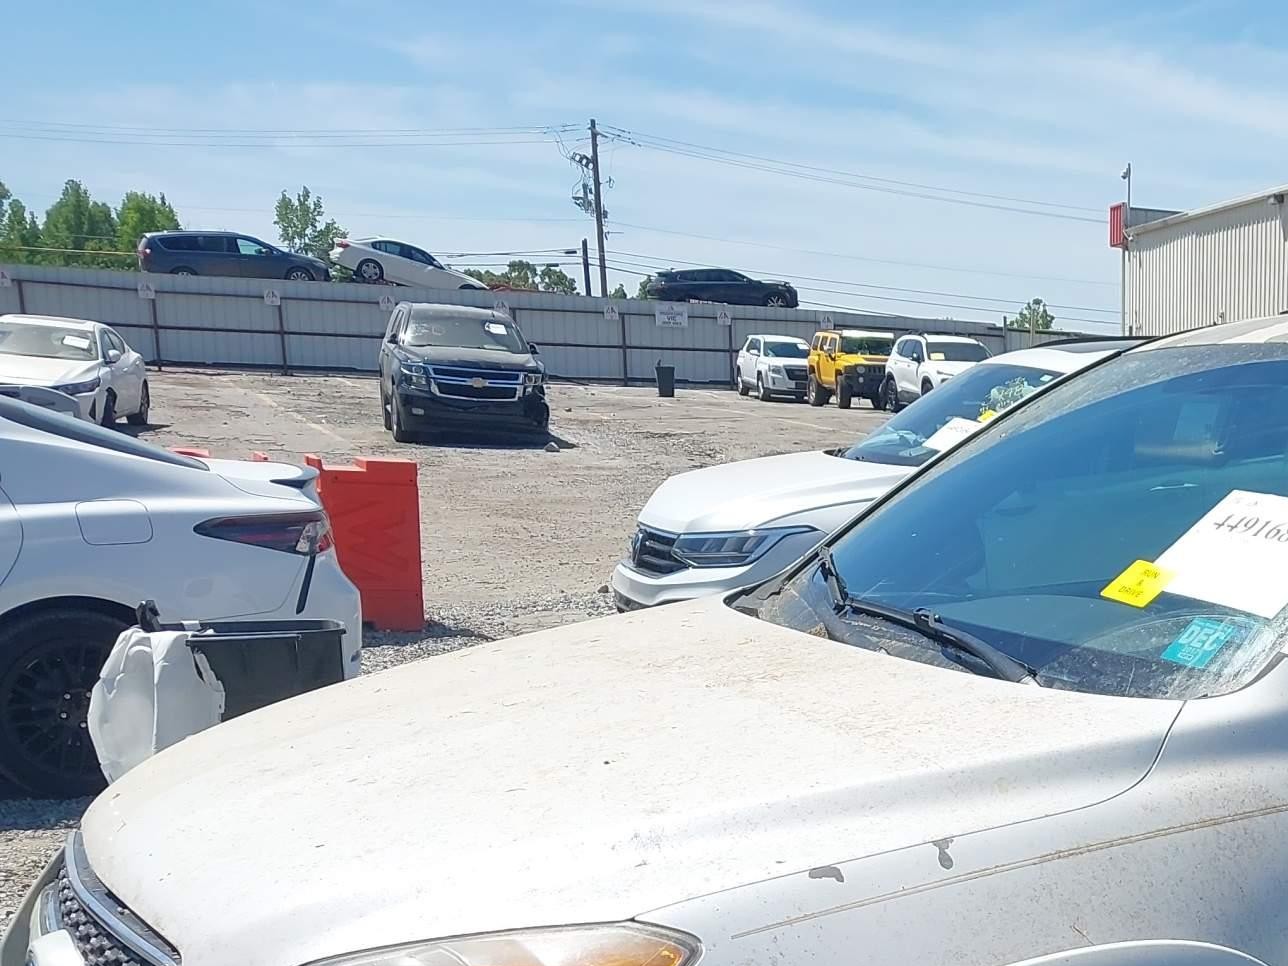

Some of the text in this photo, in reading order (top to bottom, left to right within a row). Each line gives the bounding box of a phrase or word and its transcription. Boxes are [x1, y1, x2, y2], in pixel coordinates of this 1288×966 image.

[1143, 569, 1160, 579] RUN
[1117, 585, 1144, 598] DRIVE
[1178, 624, 1225, 651] DEC
